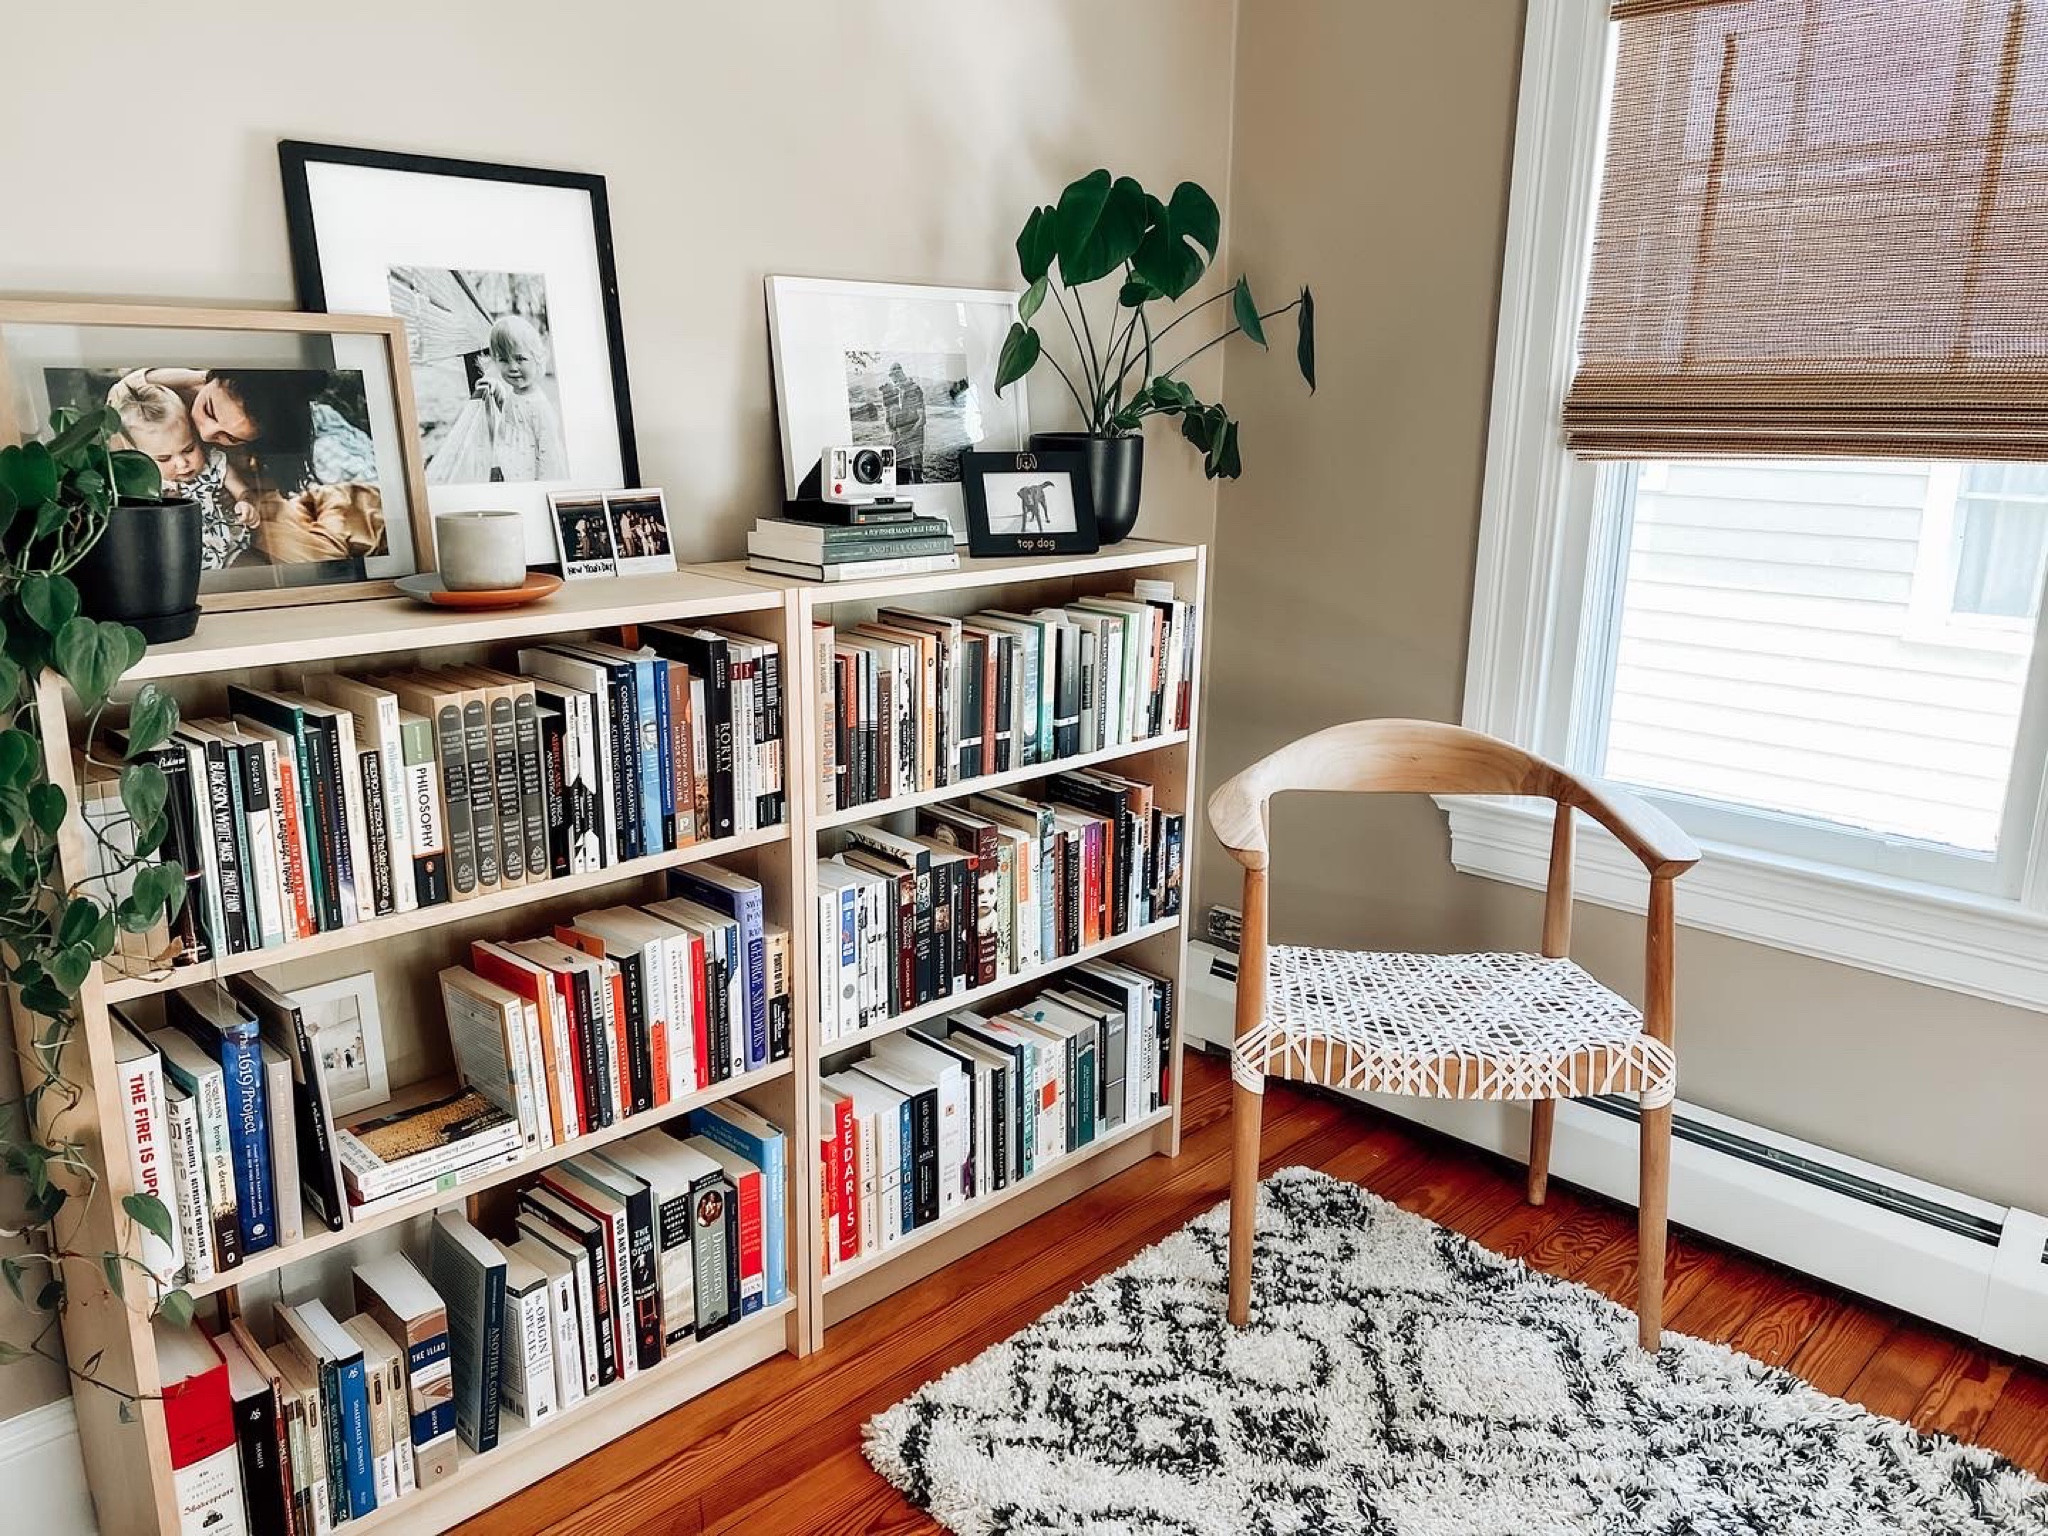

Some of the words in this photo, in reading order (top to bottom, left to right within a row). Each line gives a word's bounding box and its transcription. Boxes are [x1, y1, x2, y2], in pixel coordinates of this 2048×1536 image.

[1018, 538, 1034, 550] top
[1037, 538, 1055, 550] dog
[721, 723, 731, 772] RORTY
[210, 761, 227, 784] BLACK
[251, 755, 263, 795] Foucault
[416, 768, 433, 848] PHILOSOPHY
[750, 941, 763, 986] GEORGE
[237, 1053, 254, 1085] 1619
[129, 1074, 145, 1105] THE
[134, 1109, 150, 1143] FIRE
[241, 1087, 258, 1135] Project
[213, 1124, 224, 1152] brown
[140, 1148, 154, 1164] IS
[844, 1113, 854, 1227] SEDARIS
[142, 1169, 158, 1198] UPO
[616, 1218, 624, 1234] GOD
[618, 1237, 626, 1253] AND
[699, 1238, 709, 1253] in
[701, 1257, 713, 1309] America
[711, 1232, 723, 1302] Democracy
[526, 1309, 537, 1361] SPECIES
[536, 1306, 548, 1353] ORIGIN
[412, 1351, 425, 1362] THE
[490, 1327, 500, 1378] ANOTHER
